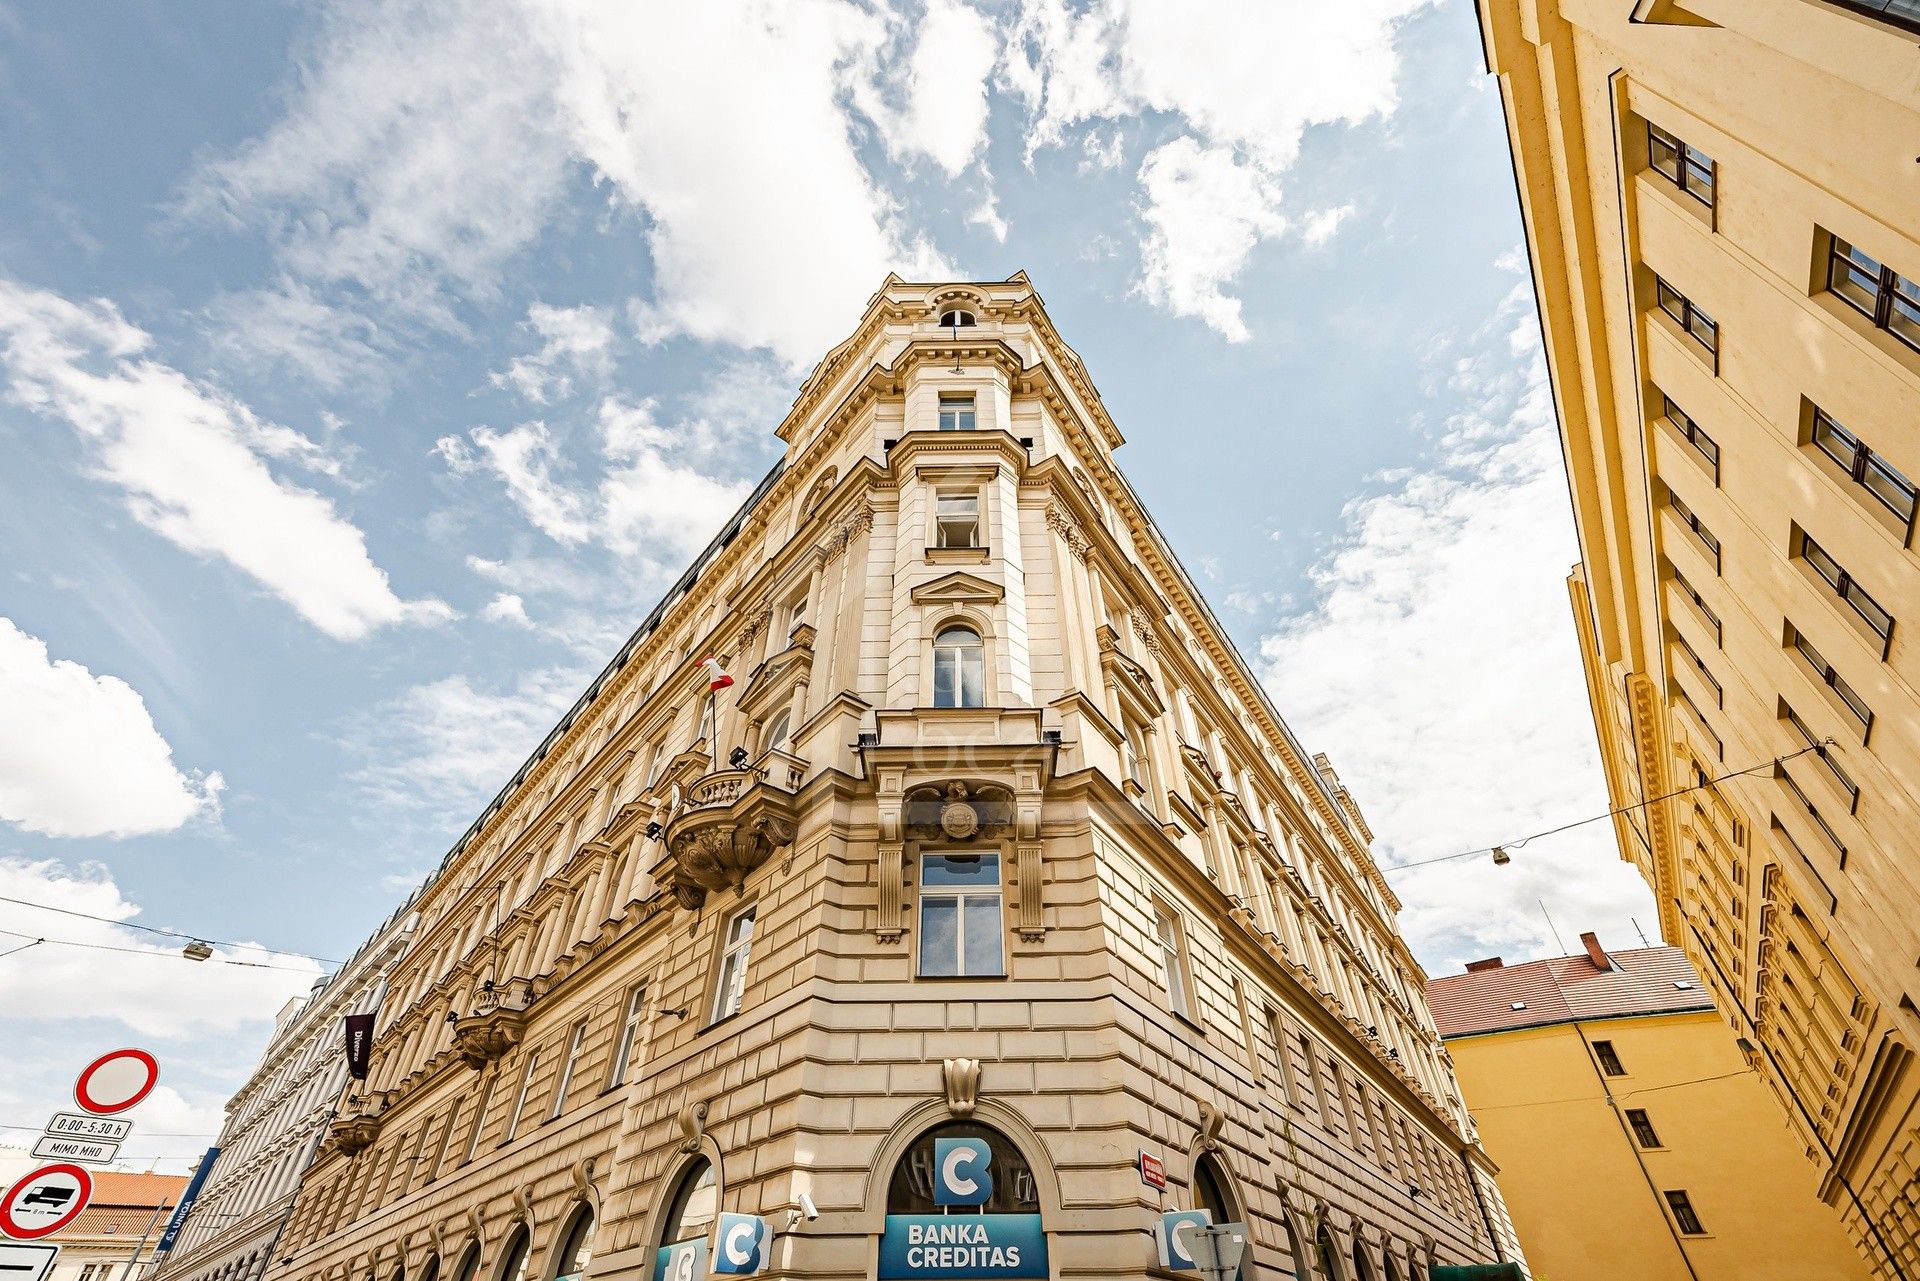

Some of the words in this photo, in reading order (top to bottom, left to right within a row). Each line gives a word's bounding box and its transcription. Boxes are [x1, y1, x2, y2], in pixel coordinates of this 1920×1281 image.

[114, 1124, 122, 1135] h
[49, 1143, 78, 1155] MIMO
[79, 1146, 103, 1157] MHD
[908, 1224, 990, 1245] BANKA
[907, 1246, 1020, 1268] CREDITAS
